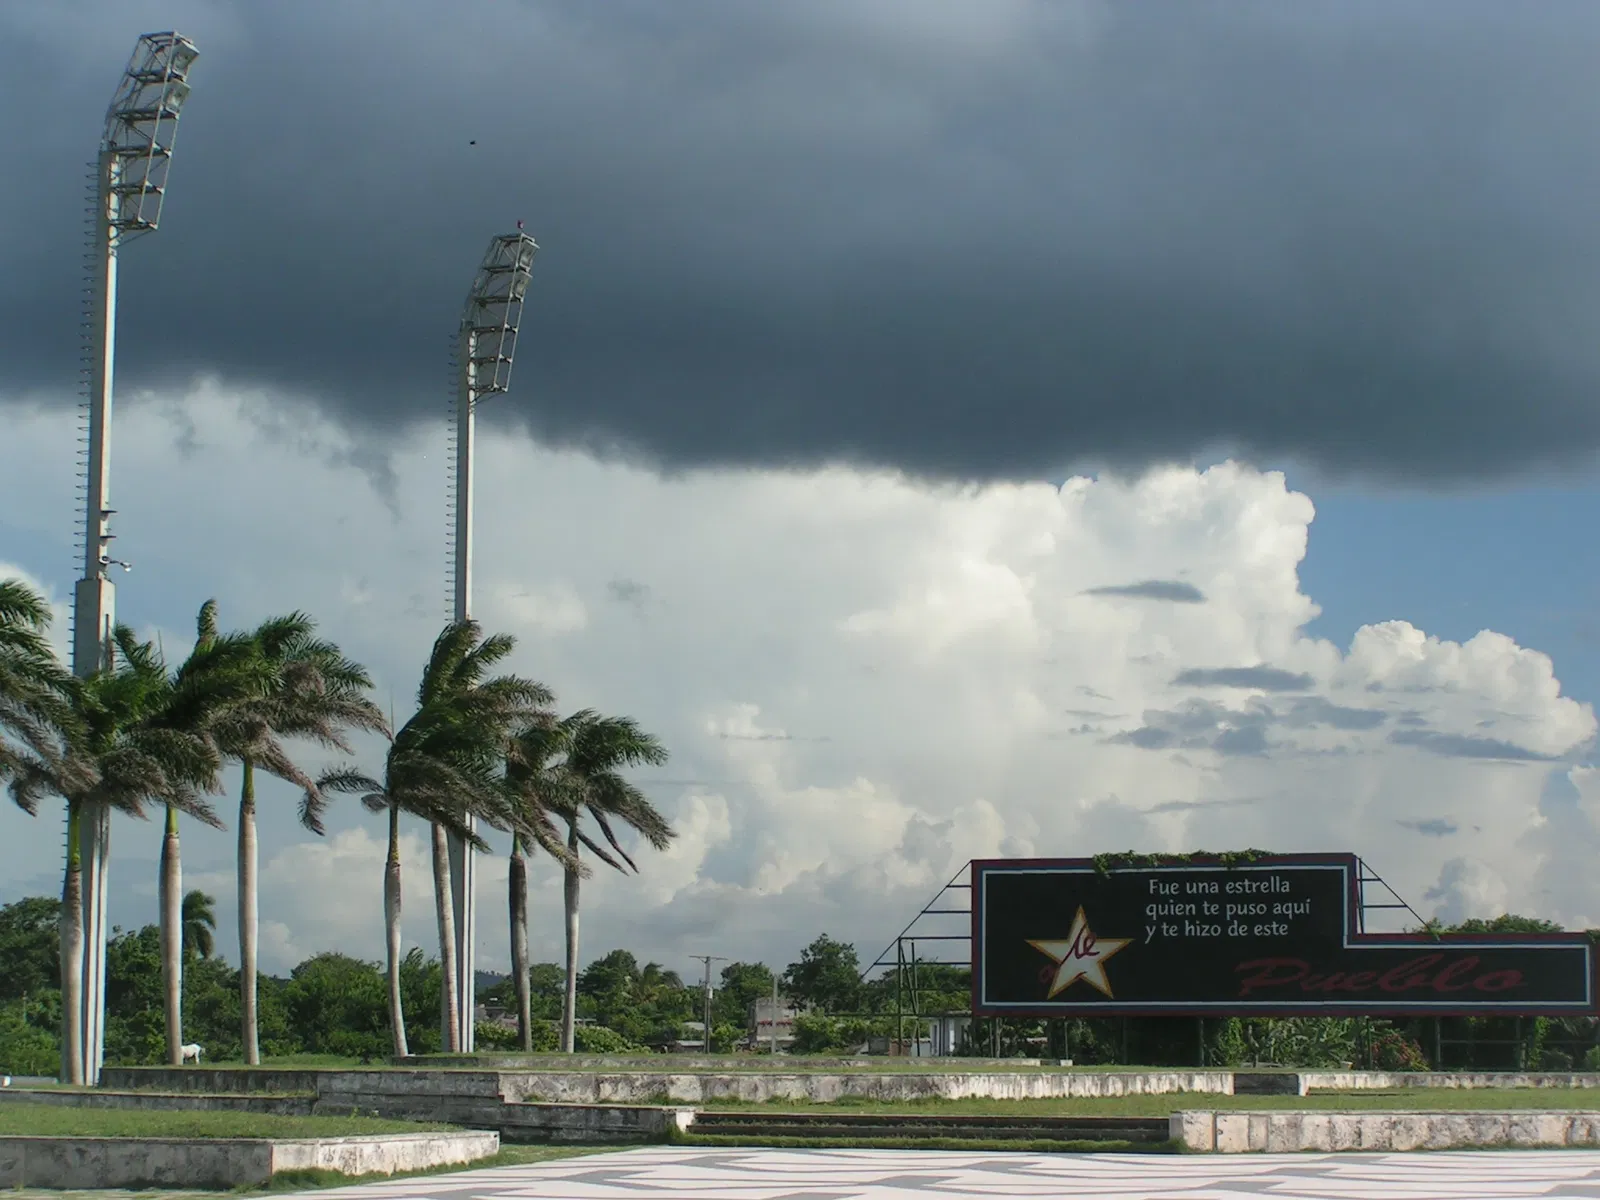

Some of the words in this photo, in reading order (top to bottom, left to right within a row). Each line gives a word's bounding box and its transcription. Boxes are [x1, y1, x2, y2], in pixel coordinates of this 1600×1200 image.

[1149, 879, 1180, 895] Fue
[1186, 881, 1219, 894] una
[1225, 876, 1290, 894] estrella
[1145, 899, 1196, 921] quien
[1203, 901, 1220, 916] te
[1226, 902, 1267, 921] puso
[1272, 898, 1311, 920] aquí
[1144, 925, 1156, 945] y
[1161, 922, 1178, 937] te
[1185, 920, 1221, 937] hizo
[1227, 921, 1248, 937] de
[1254, 921, 1288, 936] este
[1234, 953, 1529, 997] Pueblo
